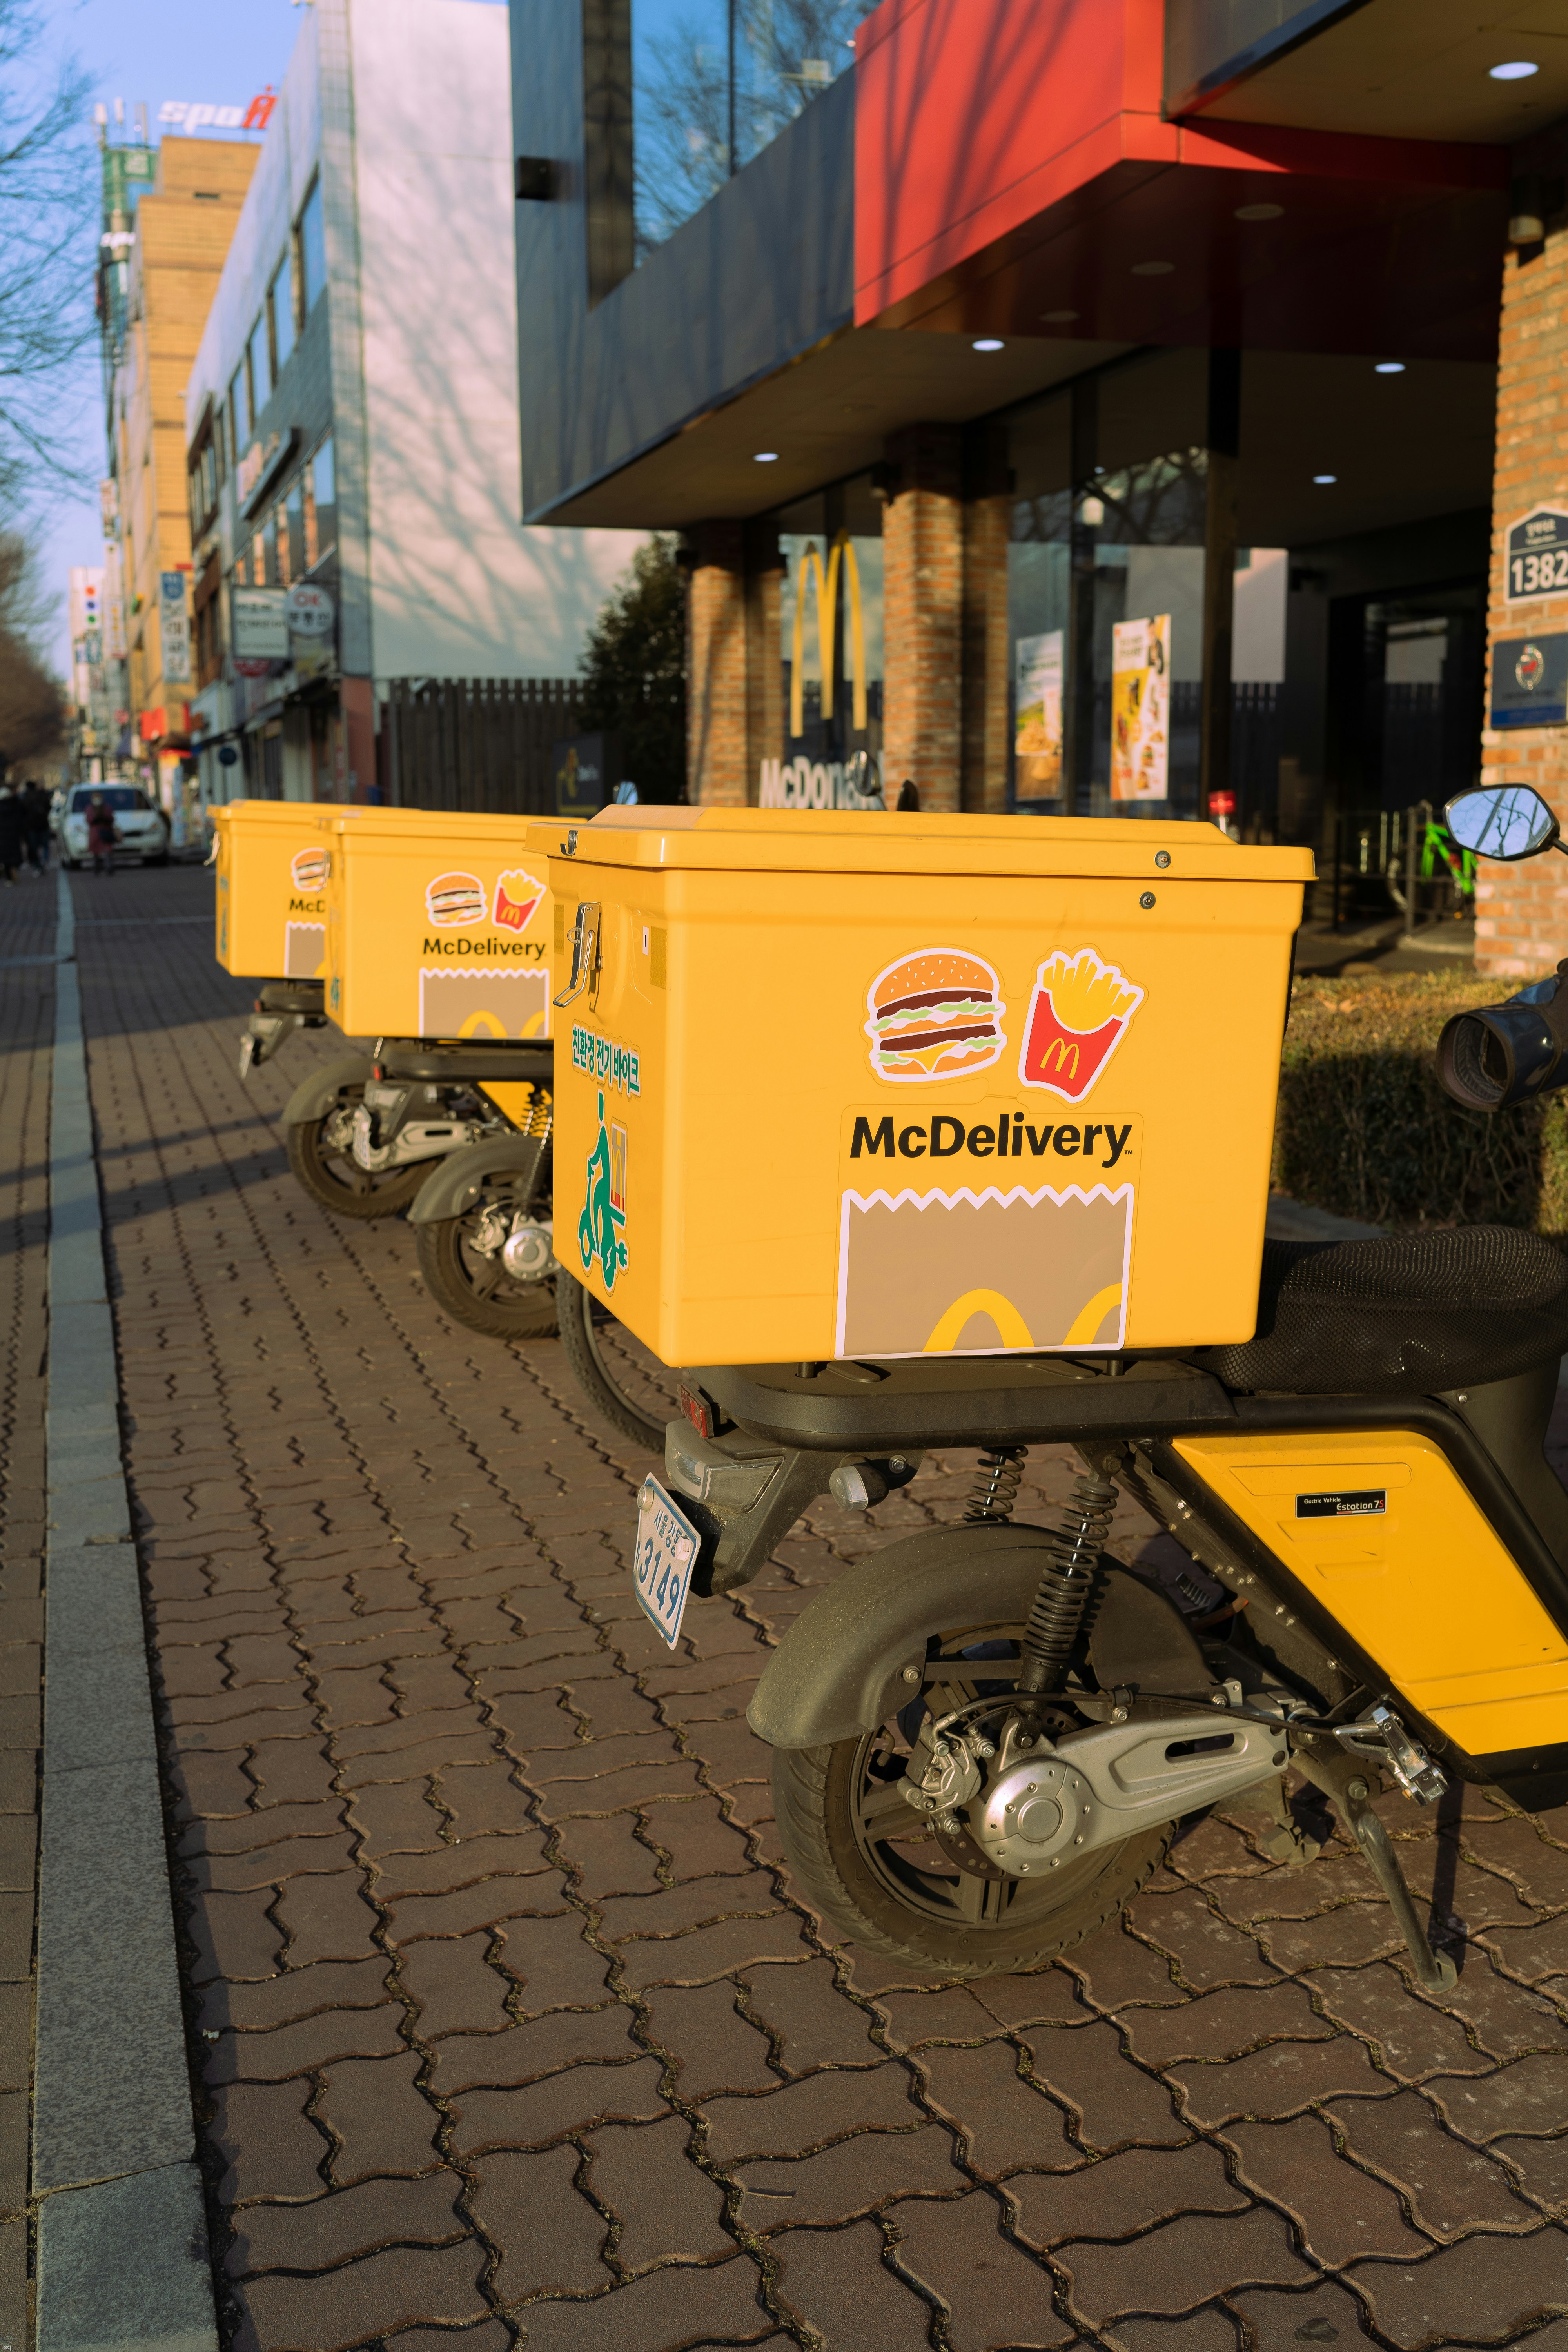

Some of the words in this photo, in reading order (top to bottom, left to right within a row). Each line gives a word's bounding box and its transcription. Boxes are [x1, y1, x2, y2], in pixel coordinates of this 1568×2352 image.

[1511, 550, 1568, 593] 1382
[573, 1027, 595, 1073] 친환경
[596, 1039, 612, 1083] 전기
[613, 1049, 639, 1093] 바이크
[654, 1509, 668, 1539] 서울
[1336, 1502, 1373, 1511] Estation
[639, 1537, 680, 1620] 3149
[833, 1760, 848, 1829] KENDA
